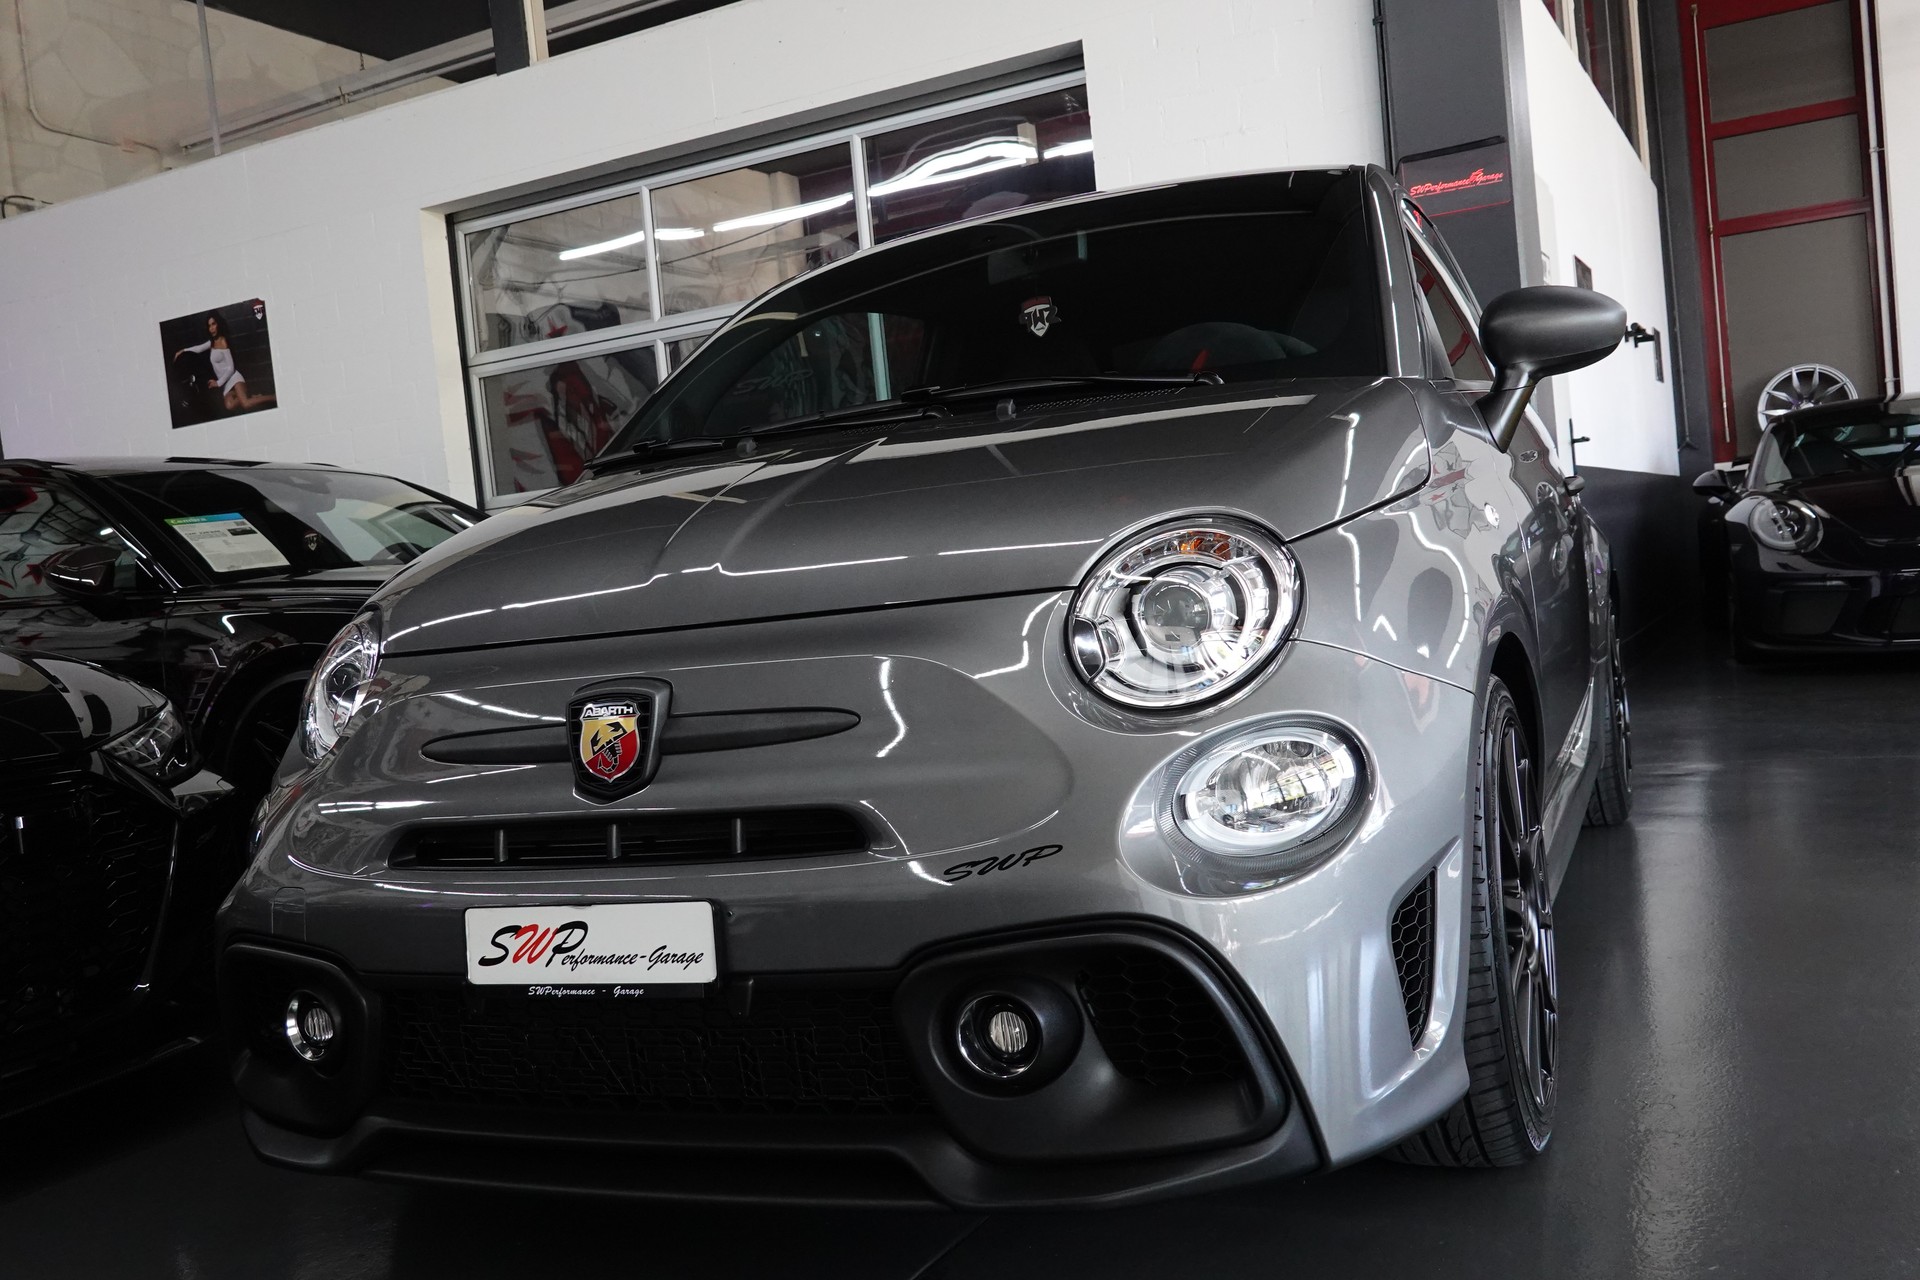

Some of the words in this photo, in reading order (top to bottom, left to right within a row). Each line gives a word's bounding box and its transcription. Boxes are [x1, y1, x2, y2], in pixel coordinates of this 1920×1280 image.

[584, 706, 634, 717] ABARTH
[943, 844, 1064, 883] SWP
[528, 985, 596, 998] SWPerformance
[613, 985, 645, 998] Garage
